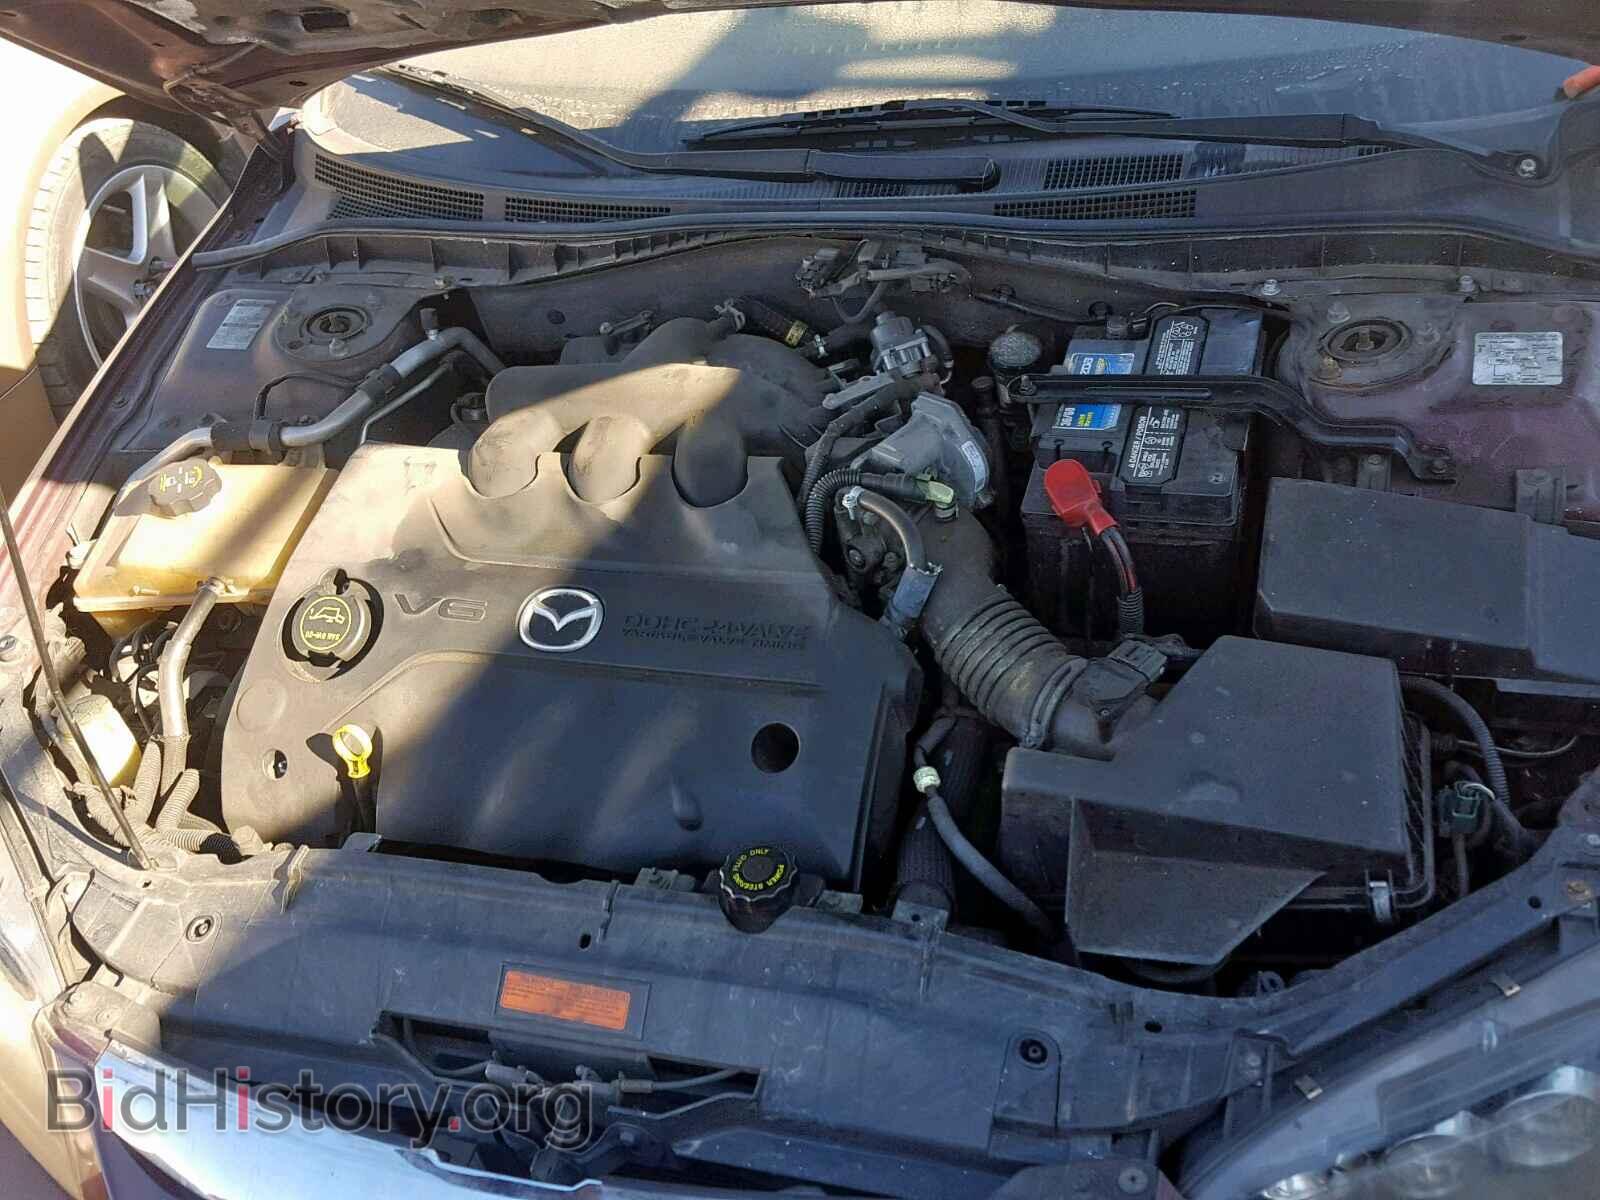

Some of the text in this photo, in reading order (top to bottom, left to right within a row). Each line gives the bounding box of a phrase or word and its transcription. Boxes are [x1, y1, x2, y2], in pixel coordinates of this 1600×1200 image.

[1129, 441, 1142, 463] DANGER
[393, 593, 487, 622] V6
[750, 848, 769, 856] ONLY
